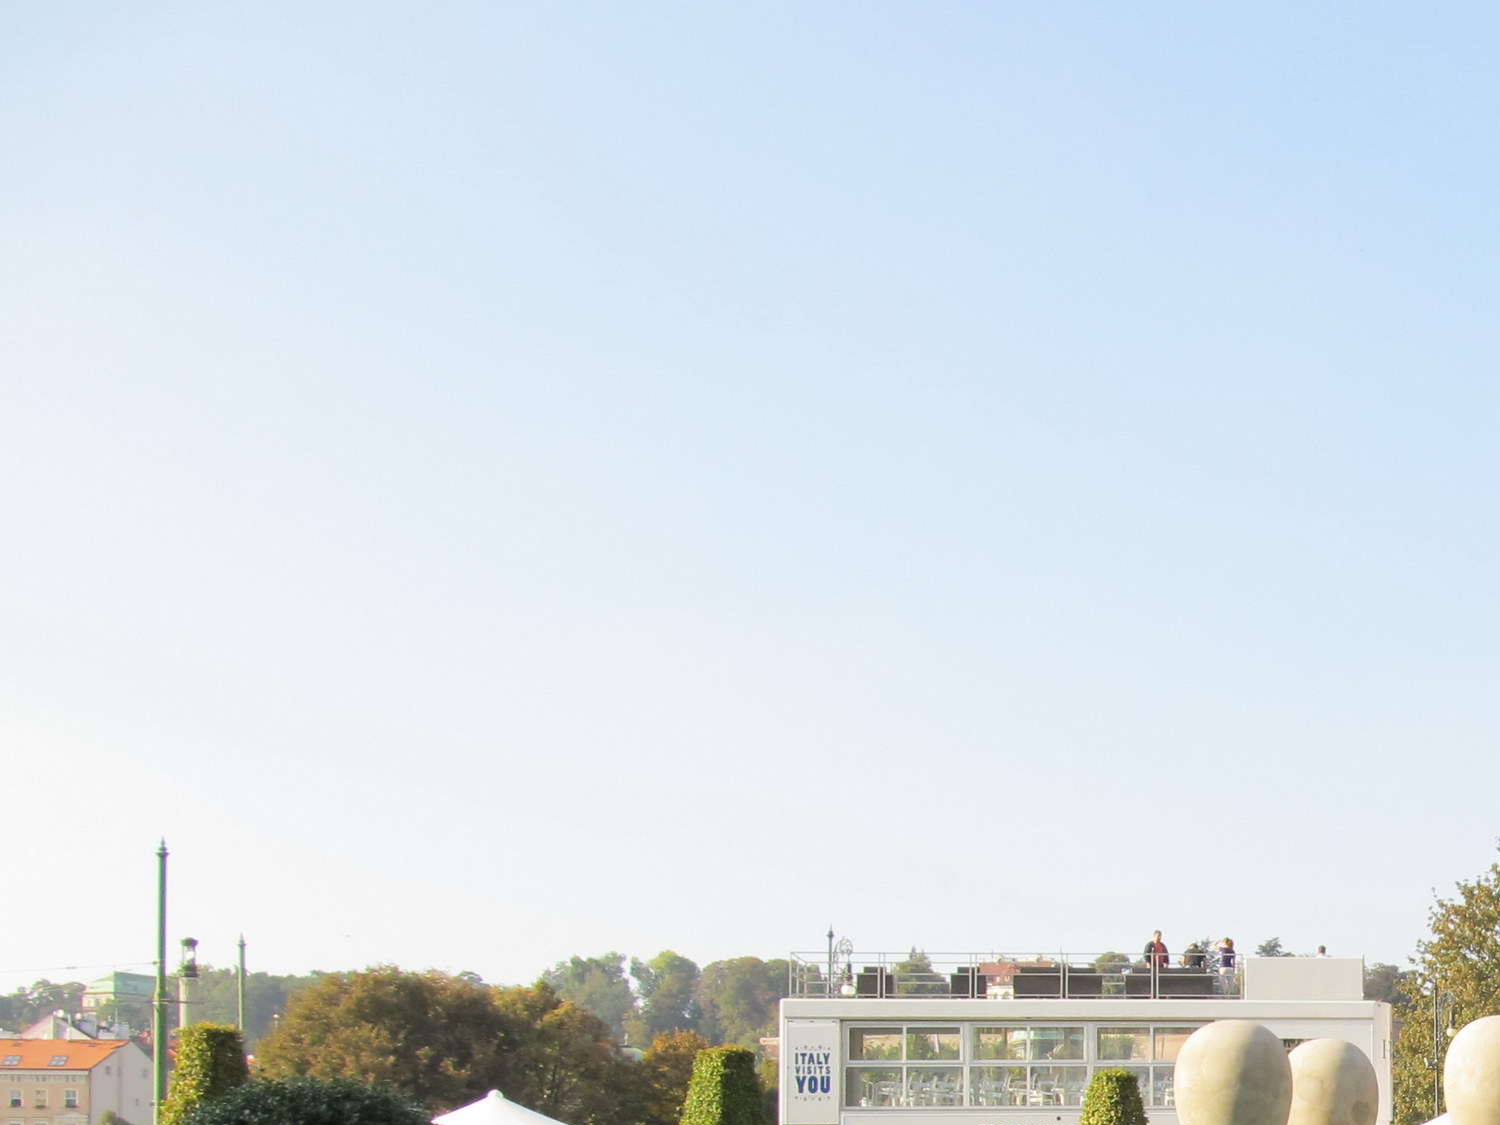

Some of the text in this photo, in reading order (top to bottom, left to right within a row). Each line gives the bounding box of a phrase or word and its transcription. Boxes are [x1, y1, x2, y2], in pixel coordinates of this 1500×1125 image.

[795, 1053, 830, 1065] ITALY
[795, 1066, 831, 1075] VISITS
[795, 1076, 831, 1094] YOU
